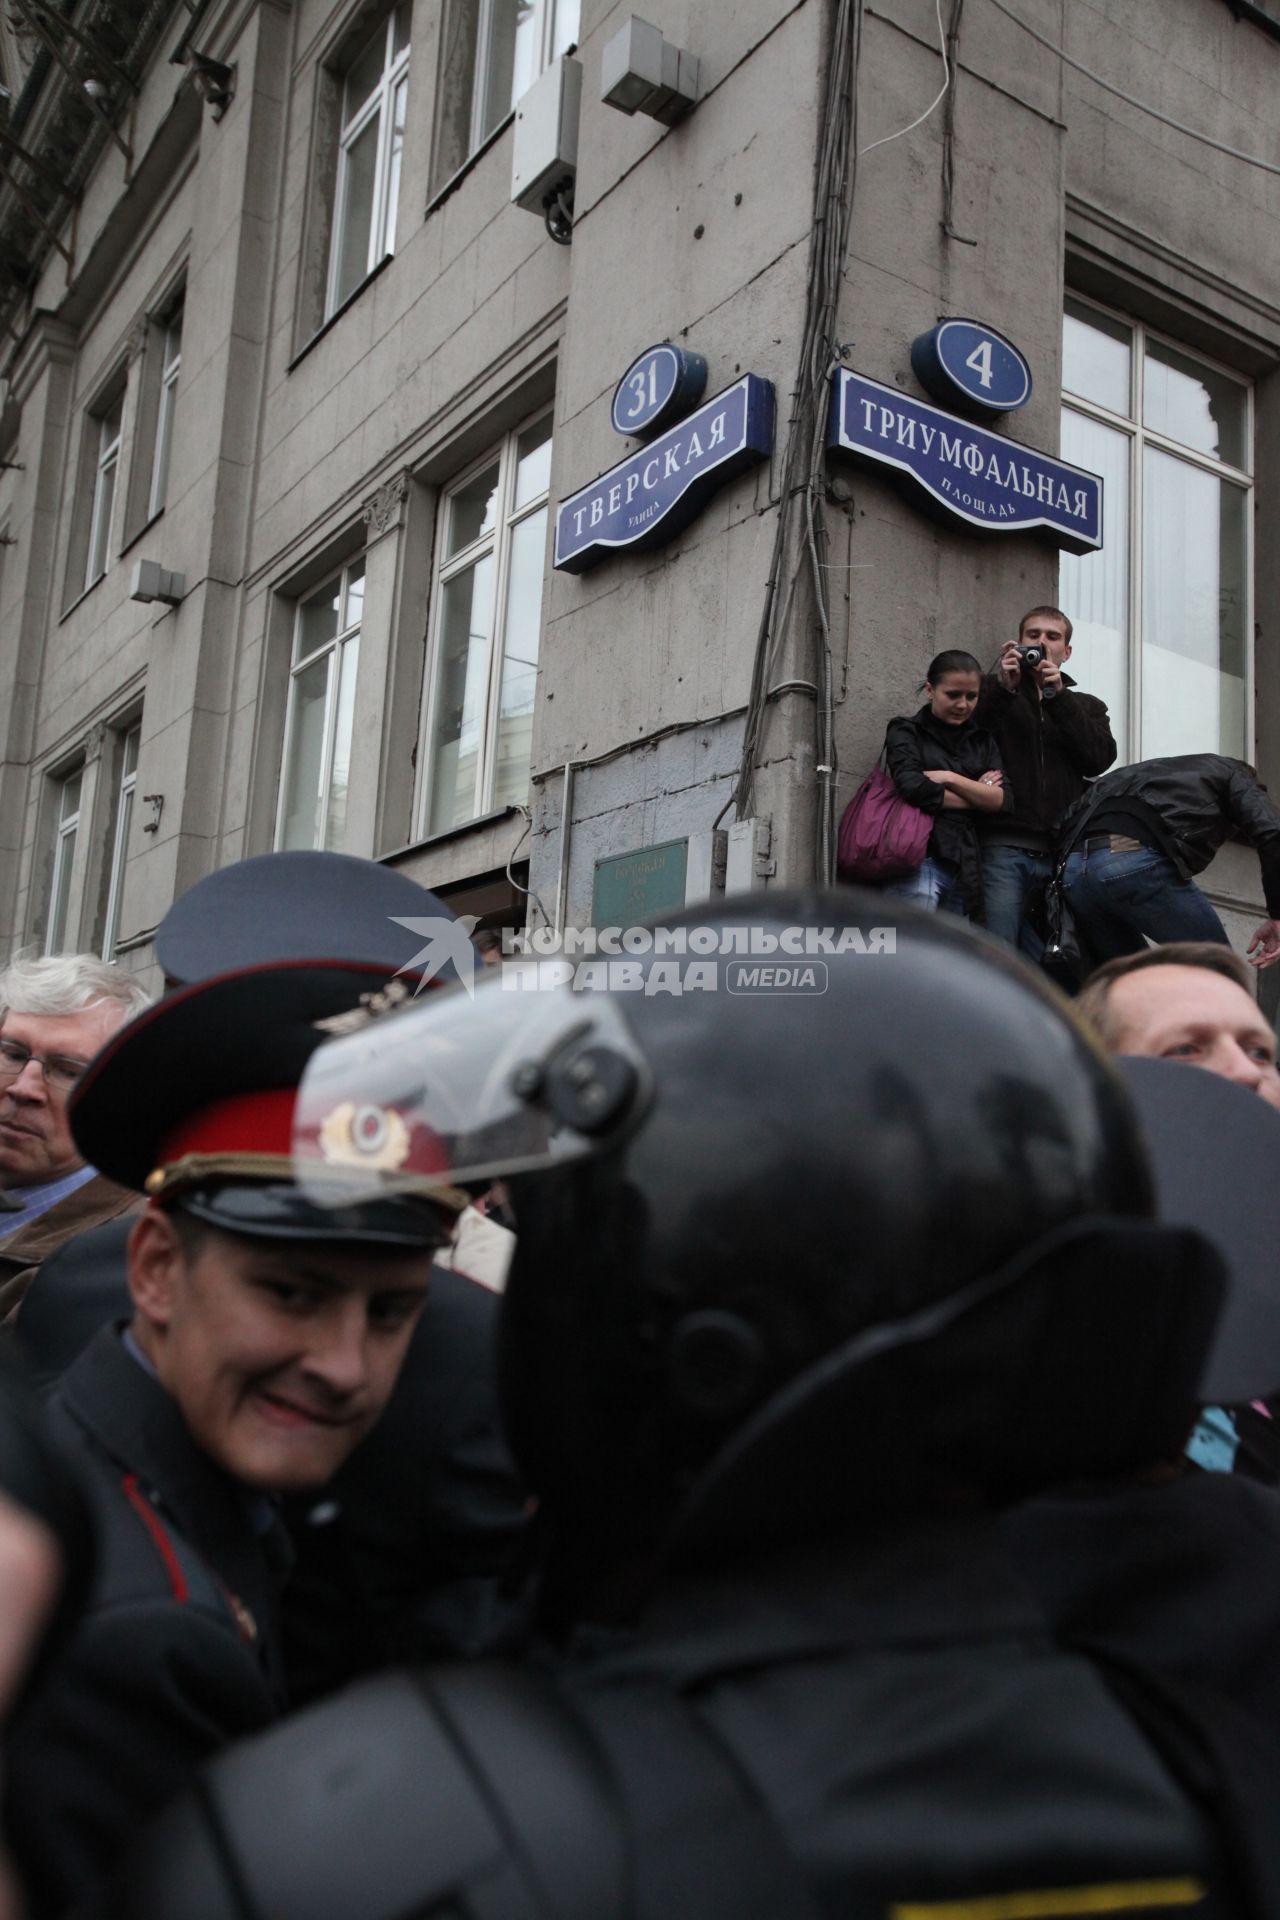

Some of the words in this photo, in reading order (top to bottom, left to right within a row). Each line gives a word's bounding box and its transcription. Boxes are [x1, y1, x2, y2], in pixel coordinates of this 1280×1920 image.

[628, 358, 657, 417] 31
[966, 340, 993, 389] 4
[573, 411, 727, 537] ТВЕРСКАЯ
[860, 398, 1088, 520] ТРИУМФАЛЬНАЯ
[628, 501, 661, 528] УЛИЦА
[940, 476, 1016, 518] ПЛОЩАДЬ
